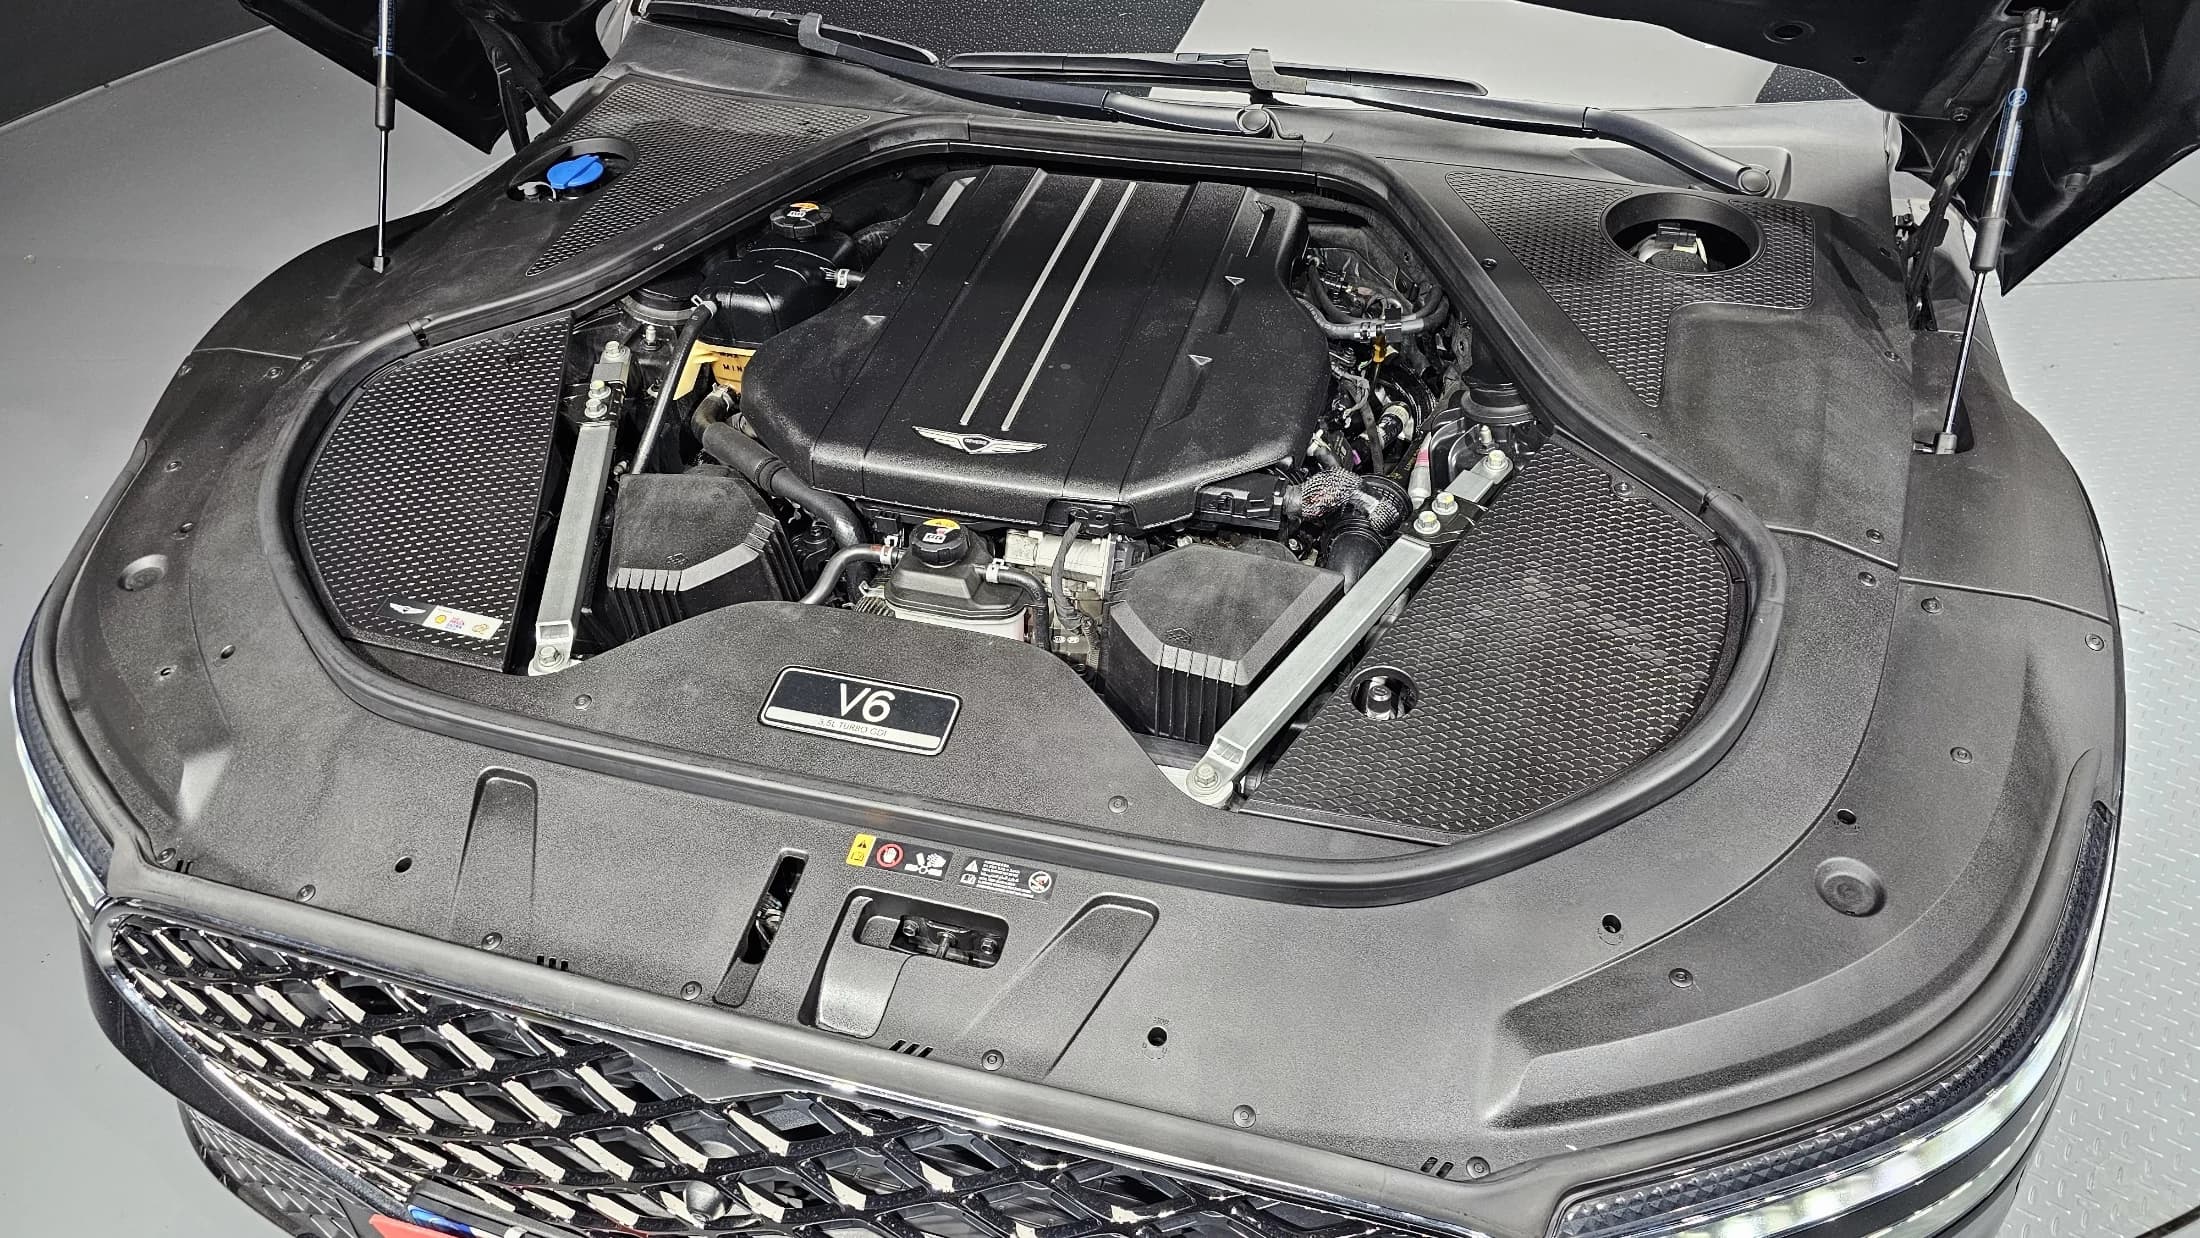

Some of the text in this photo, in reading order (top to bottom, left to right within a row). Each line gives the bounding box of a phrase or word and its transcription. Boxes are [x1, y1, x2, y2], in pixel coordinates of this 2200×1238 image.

[723, 363, 743, 372] MIN
[840, 682, 896, 722] V6
[839, 721, 868, 734] TURBO
[870, 727, 888, 737] GDI
